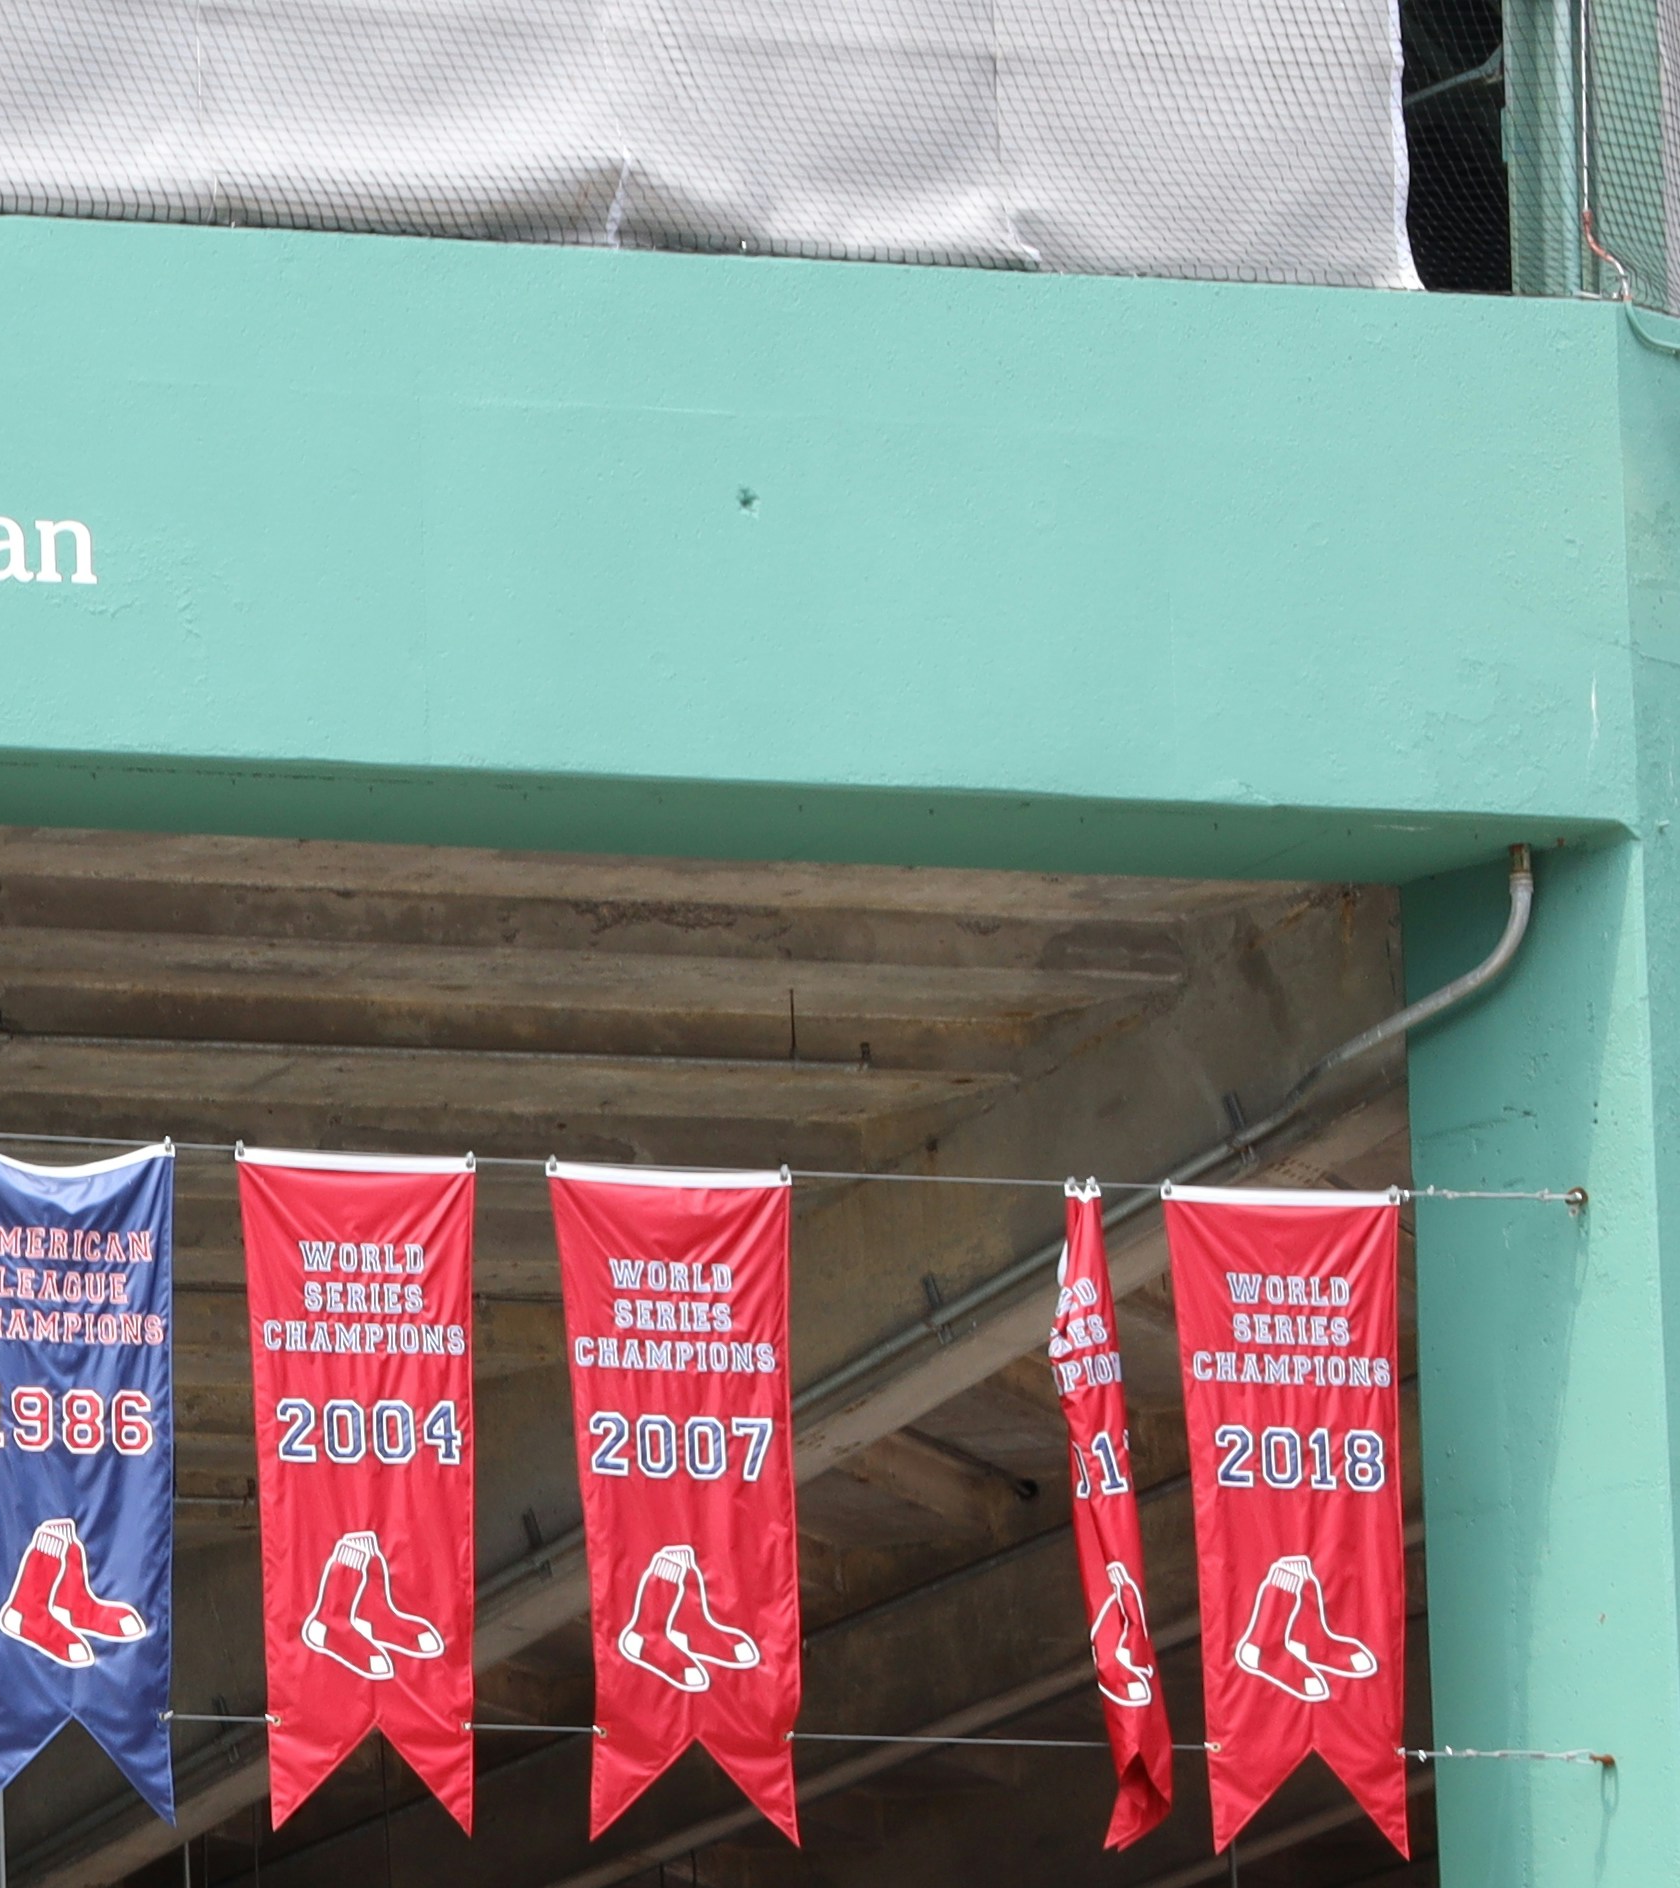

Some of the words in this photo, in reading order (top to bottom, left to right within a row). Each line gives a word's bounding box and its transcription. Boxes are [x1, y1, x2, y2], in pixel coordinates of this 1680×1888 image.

[298, 1240, 424, 1275] WORLD
[609, 1257, 734, 1294] WORLD
[304, 1281, 423, 1316] SERIES
[1226, 1271, 1351, 1307] WORLD
[614, 1297, 733, 1333] SERIES
[1233, 1313, 1351, 1346] SERIES
[262, 1320, 465, 1356] CHAMPIONS
[574, 1335, 777, 1374] CHAMPIONS
[1193, 1351, 1391, 1388] CHAMPIONS
[276, 1398, 462, 1465] 2004
[589, 1411, 774, 1483] 2007
[1215, 1425, 1385, 1492] 2018
